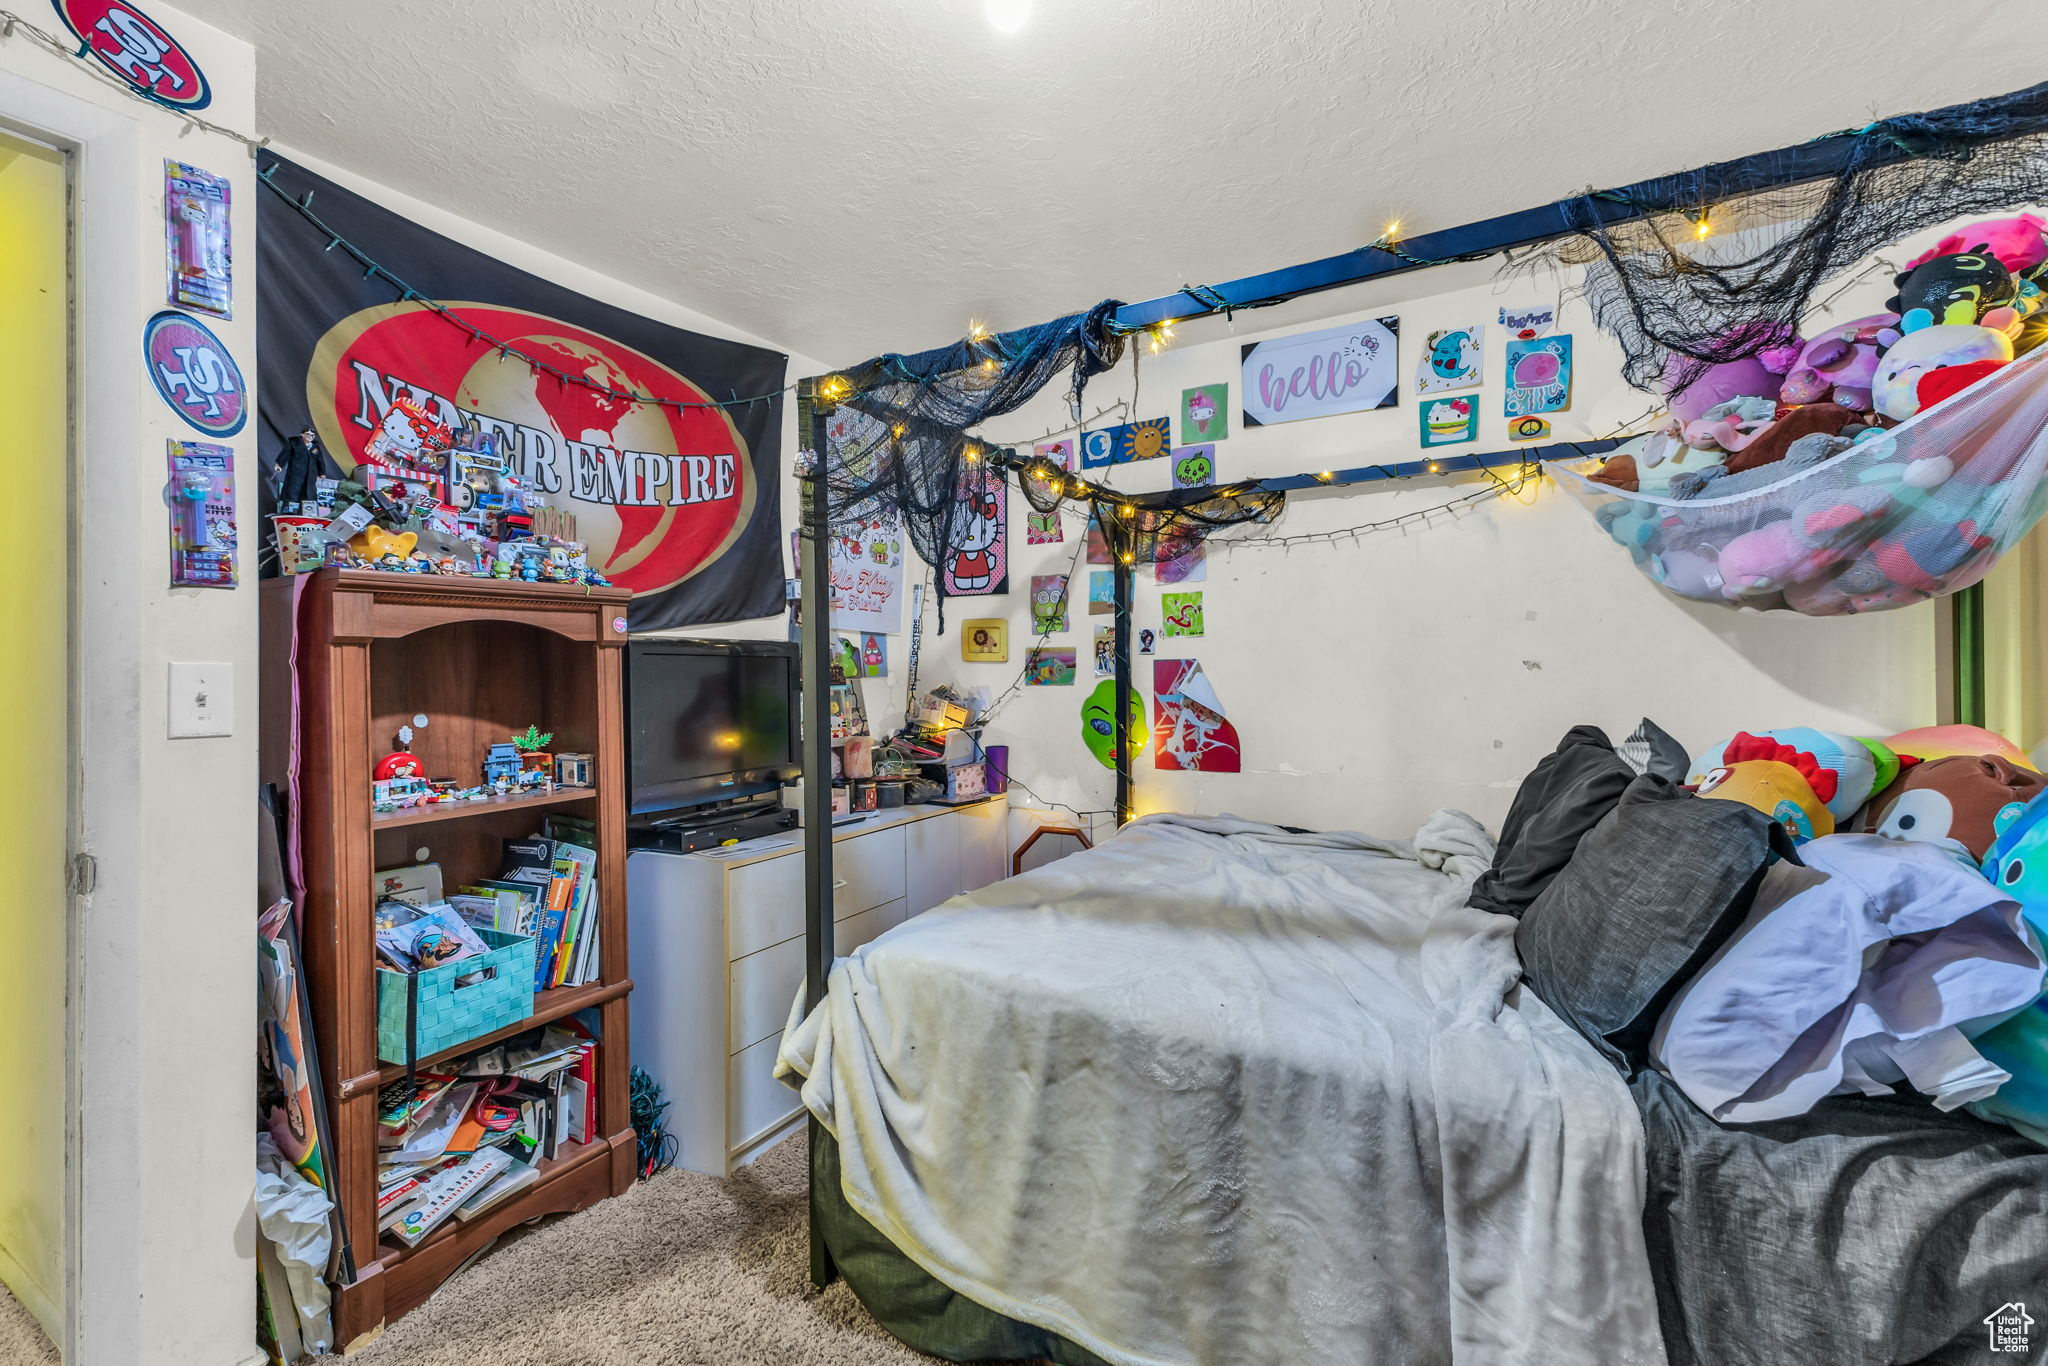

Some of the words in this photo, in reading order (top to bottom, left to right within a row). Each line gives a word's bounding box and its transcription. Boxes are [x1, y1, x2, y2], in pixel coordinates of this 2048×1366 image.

[172, 179, 223, 202] PEZ
[1258, 351, 1369, 412] hello
[174, 456, 226, 471] PEZ
[566, 438, 736, 507] EMPIRE
[205, 503, 232, 511] HELLO
[193, 562, 219, 571] PEZ
[193, 571, 219, 580] PEZ
[829, 568, 854, 591] ello
[856, 568, 894, 604] Kitty
